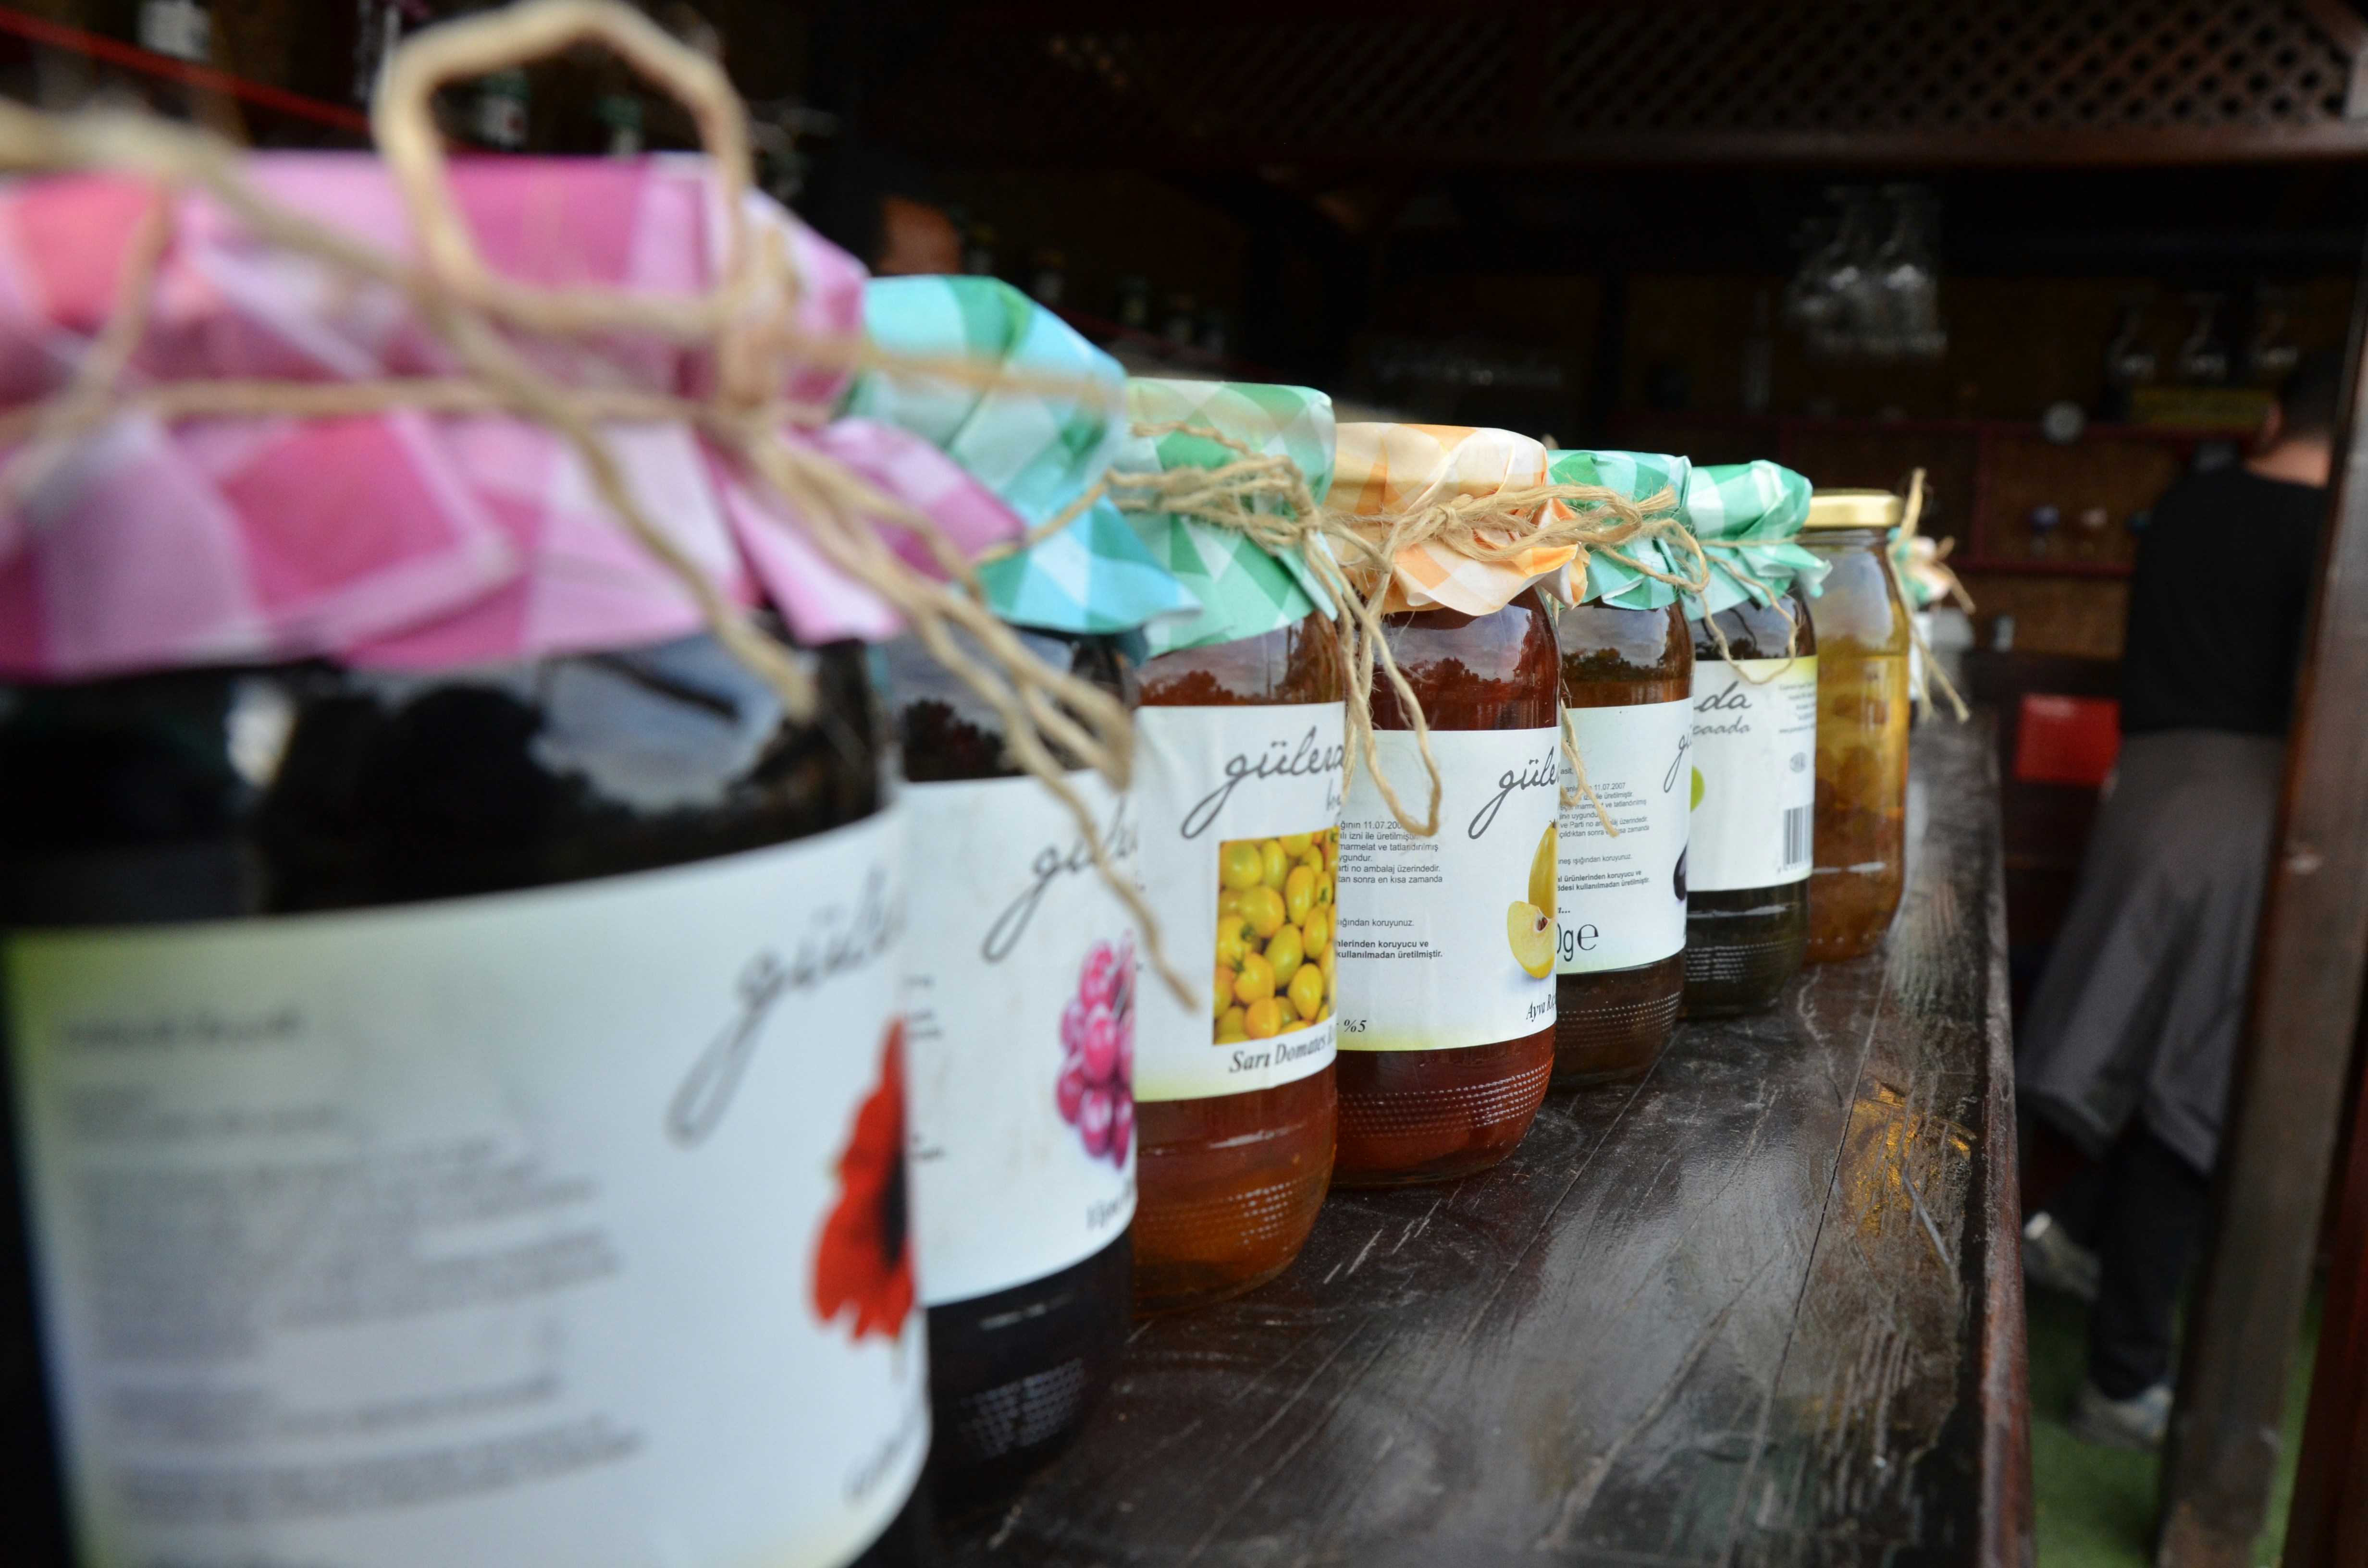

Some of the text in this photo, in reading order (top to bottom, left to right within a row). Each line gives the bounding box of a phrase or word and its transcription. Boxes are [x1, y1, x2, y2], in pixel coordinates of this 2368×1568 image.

[1594, 783, 1626, 791] 11.07.2007
[1604, 792, 1634, 800] üretilmiştir.
[1614, 799, 1647, 808] tatlandırılmış
[1619, 816, 1648, 825] üzerindedir.
[1559, 831, 1586, 839] çıldıktan
[1628, 825, 1650, 833] zamanda
[1390, 843, 1439, 852] tatlandırılmış
[1573, 856, 1601, 865] ışığından
[1602, 854, 1632, 862] koruyunuz.
[1364, 865, 1395, 874] ambalaj
[1408, 875, 1443, 883] zamanda
[1564, 873, 1605, 882] ürünlerinden
[1607, 871, 1634, 880] koruyucu
[1576, 881, 1620, 890] kullanılmadan
[1621, 877, 1651, 886] üretilmiştir.
[1372, 919, 1415, 928] koruyunuz.
[1378, 940, 1417, 949] koruyucu
[1397, 950, 1443, 959] üretilmiştir.
[1526, 1001, 1546, 1023] Ayva
[1344, 1019, 1367, 1032] %5
[1229, 1049, 1271, 1074] Sarı
